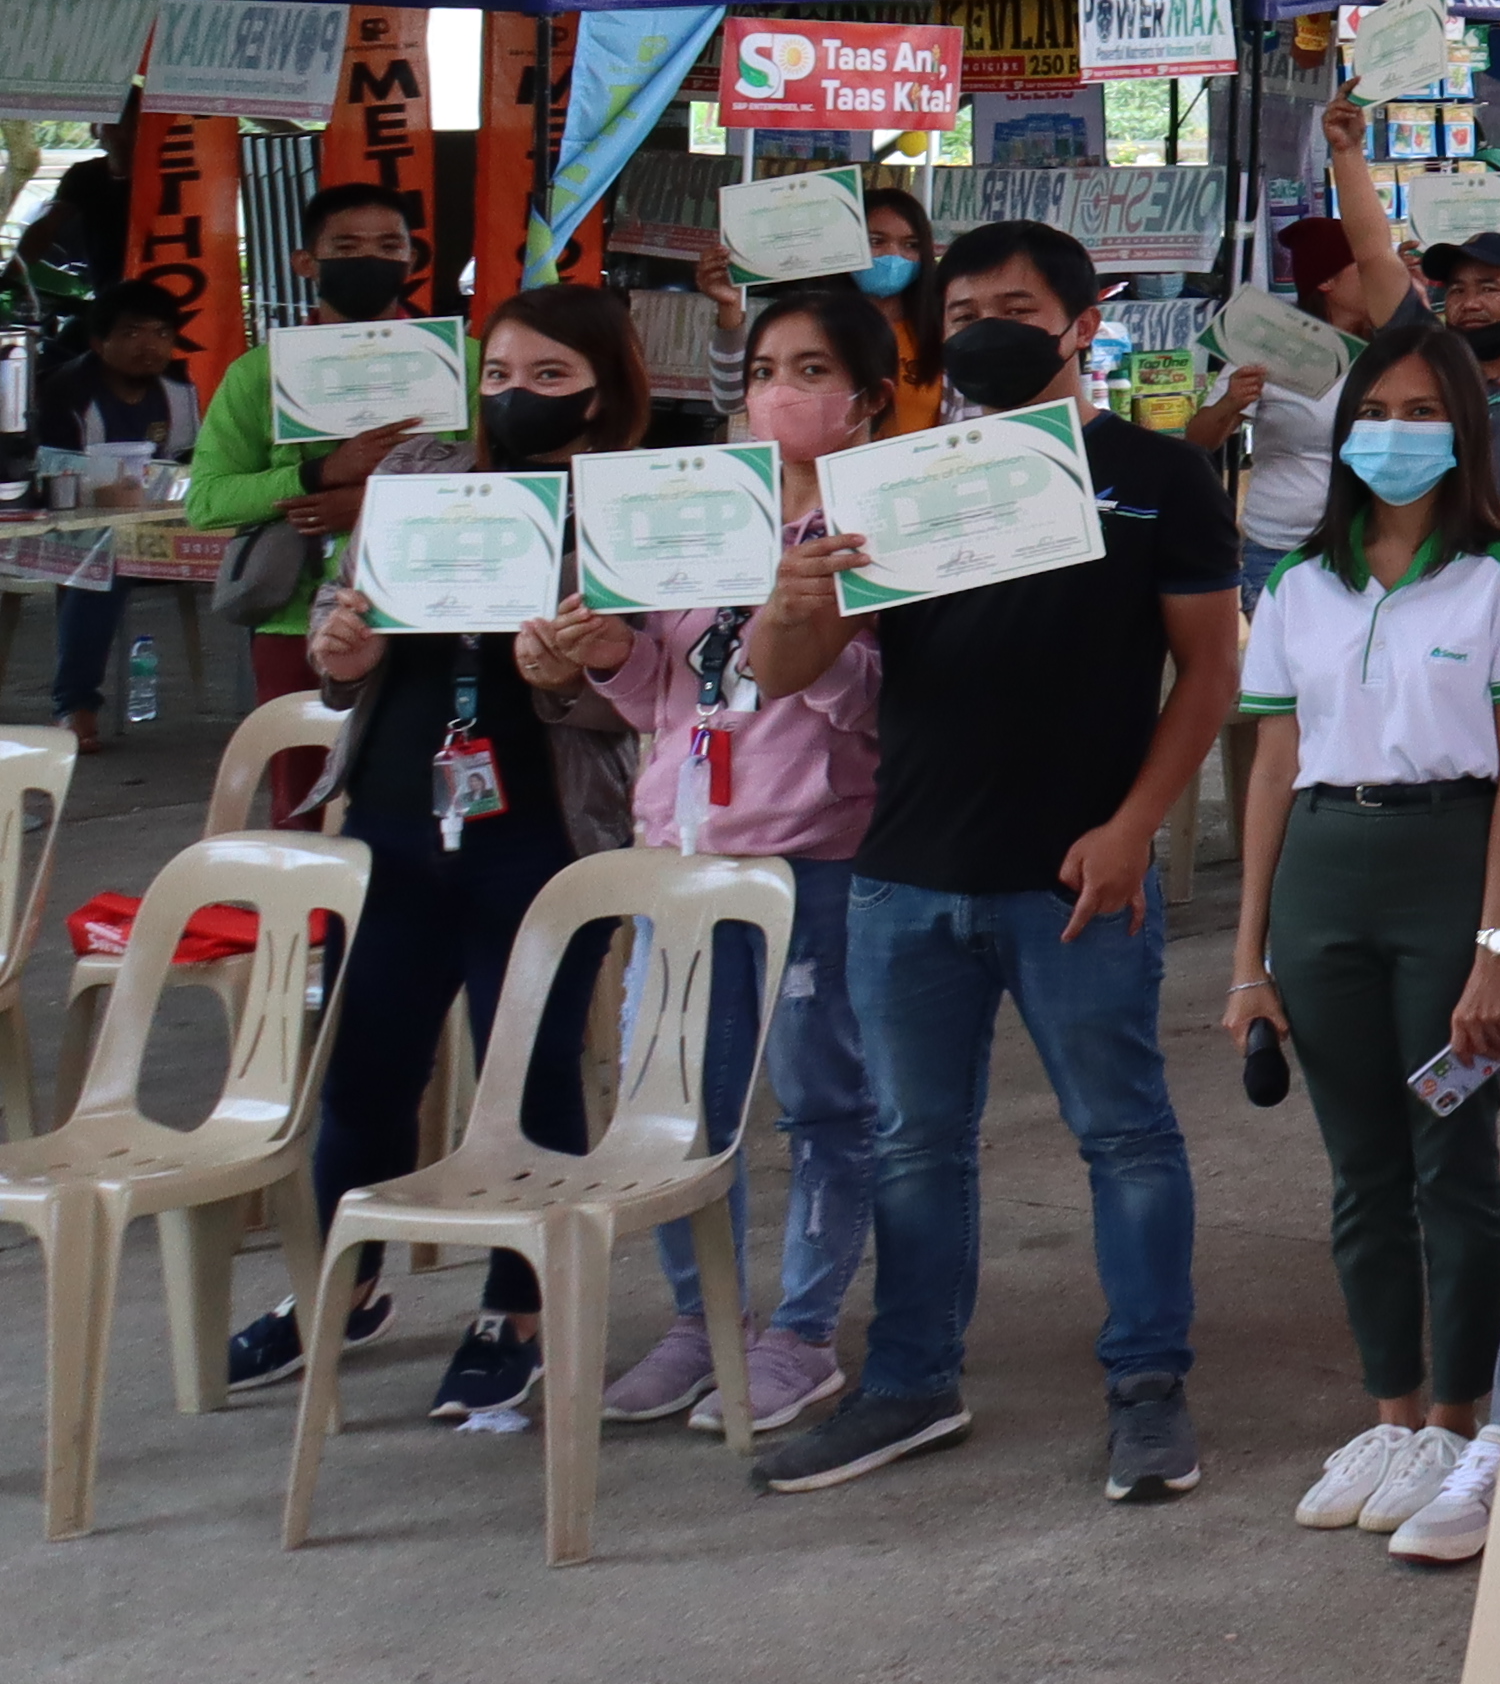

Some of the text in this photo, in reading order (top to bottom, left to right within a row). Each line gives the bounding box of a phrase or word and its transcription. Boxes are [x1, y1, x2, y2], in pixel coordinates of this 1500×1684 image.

[821, 39, 887, 71] Taas
[1029, 55, 1064, 76] 250
[821, 79, 886, 111] Taas
